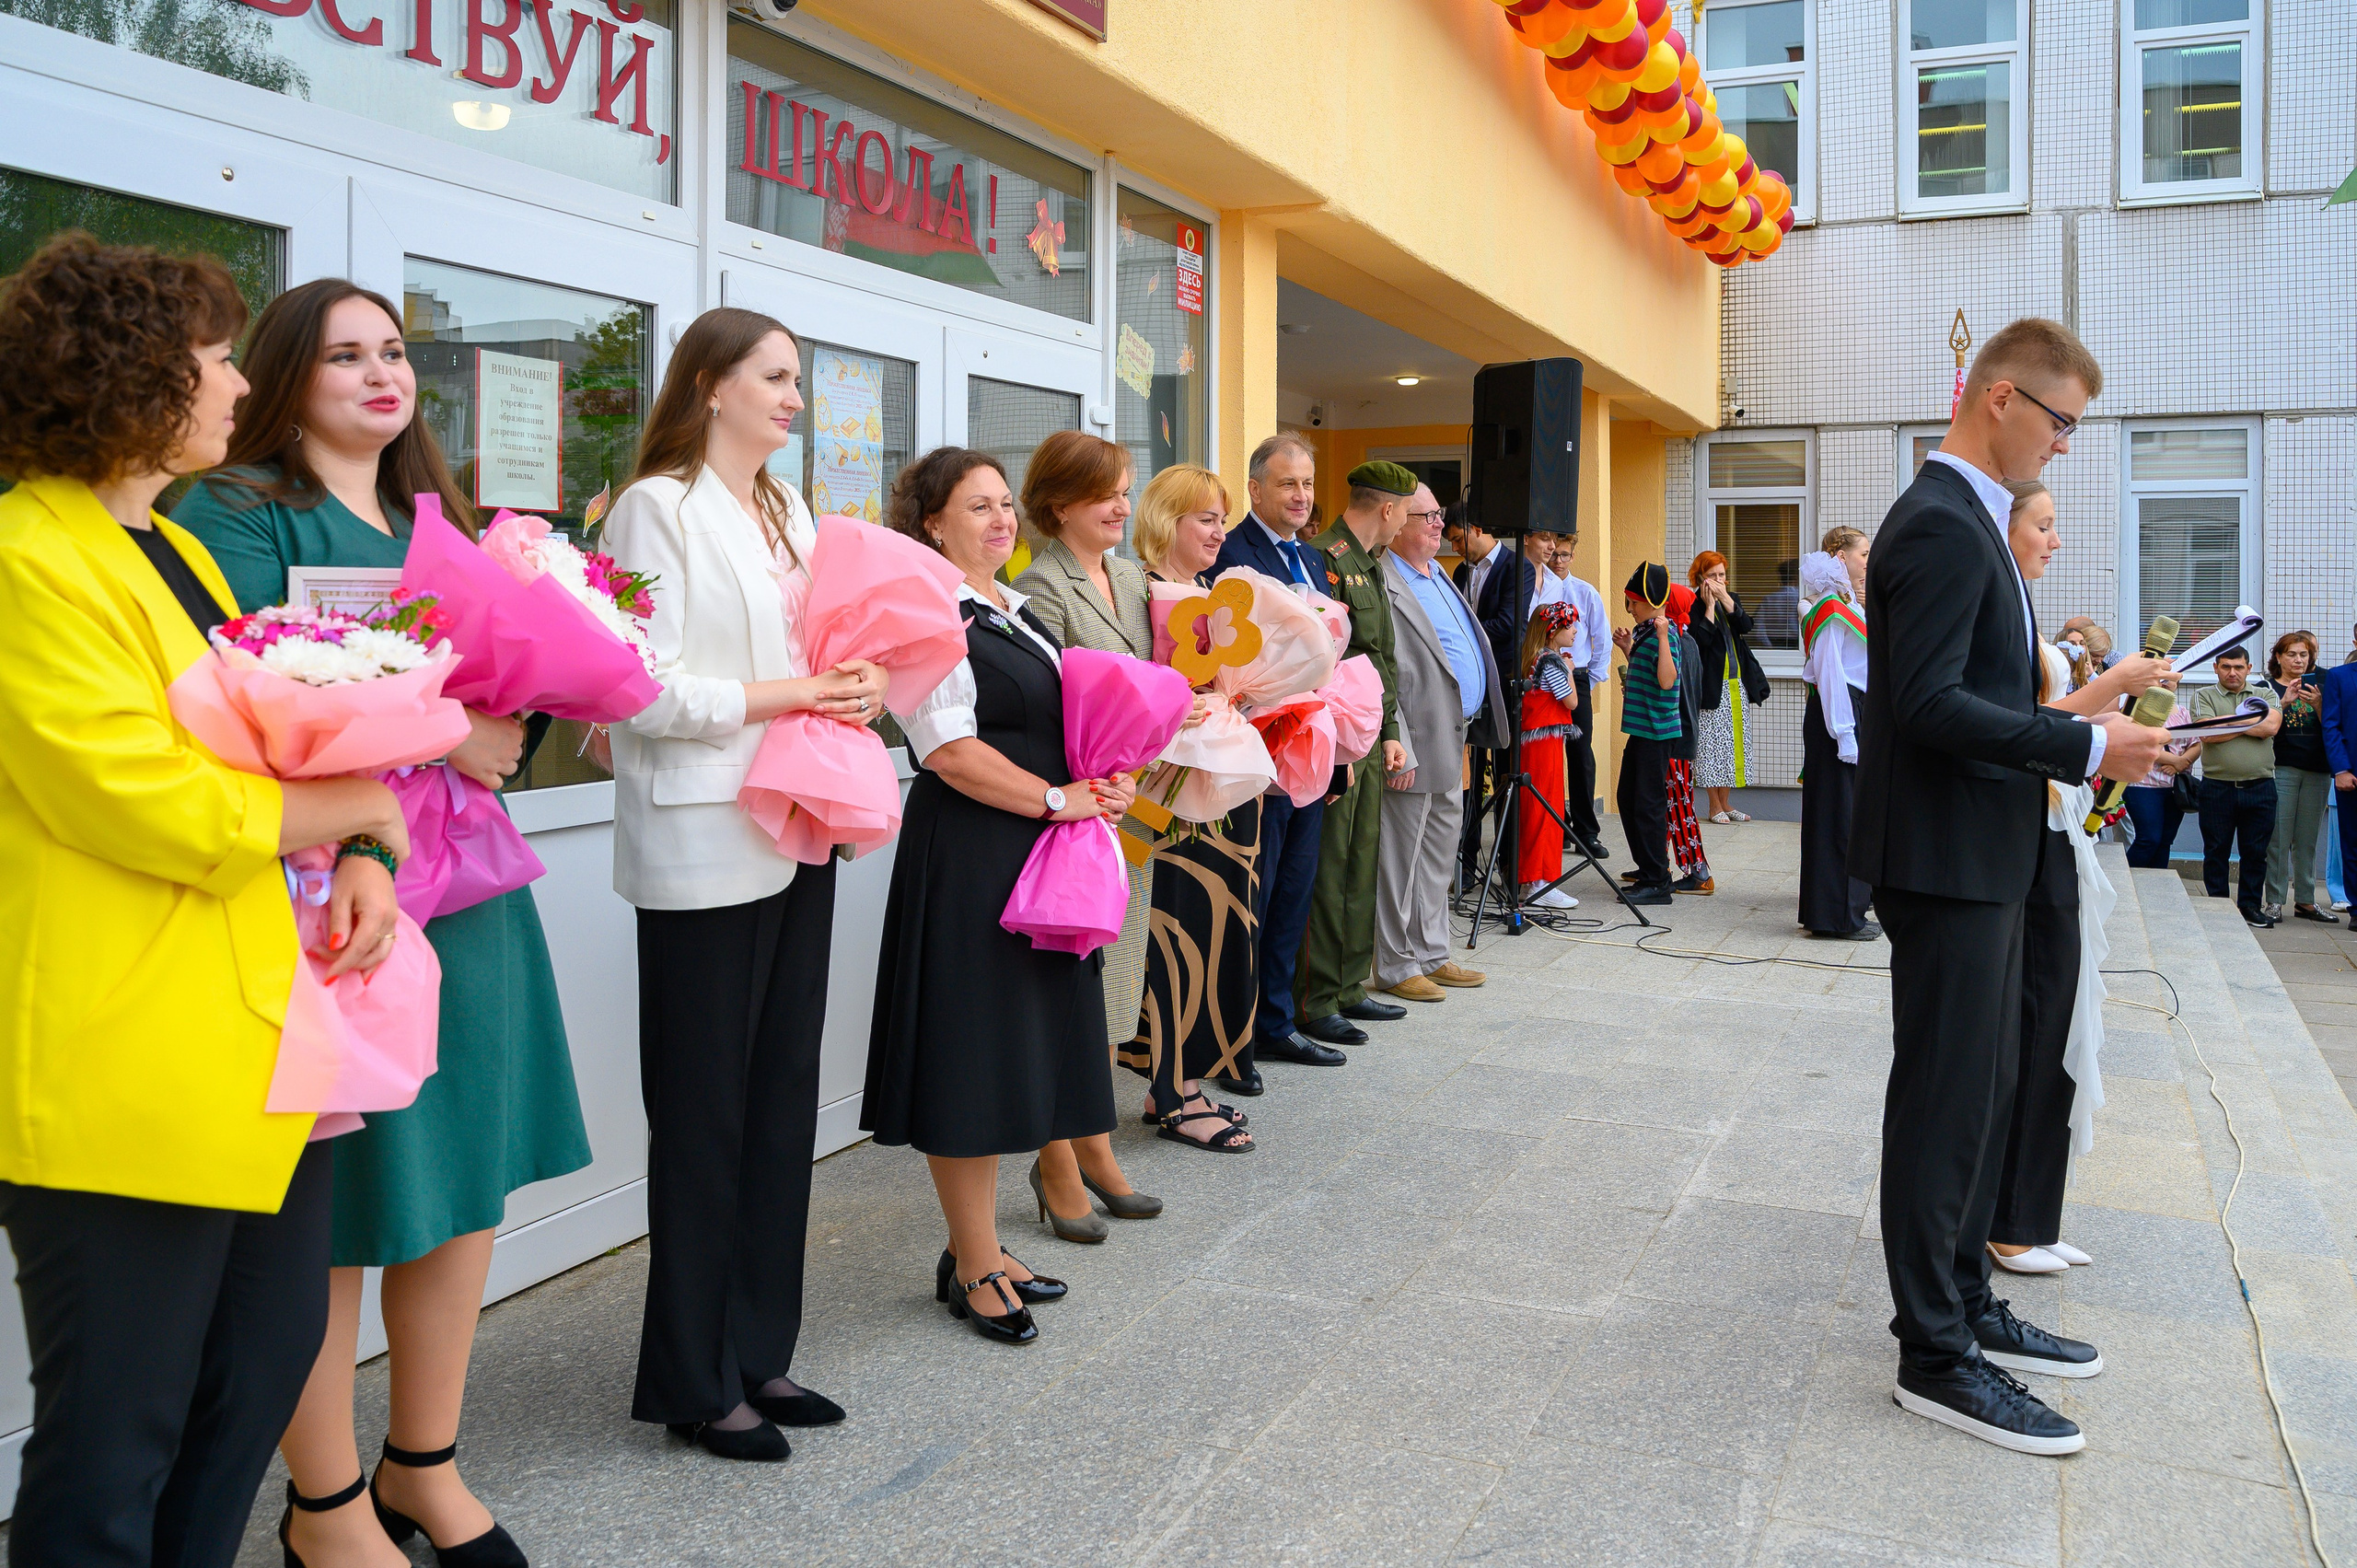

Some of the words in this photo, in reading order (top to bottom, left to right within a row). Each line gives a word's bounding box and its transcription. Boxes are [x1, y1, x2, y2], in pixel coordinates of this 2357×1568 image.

[740, 80, 998, 254] ШКОЛА!
[1178, 268, 1201, 288] ЗДЕСЬ
[1178, 296, 1201, 312] МИЛИЦИЮ
[491, 363, 552, 382] ВНИМАНИЕ!
[510, 383, 527, 394] Вход
[500, 399, 543, 411] учреждение
[498, 412, 544, 425] образования
[491, 427, 525, 438] разрешен
[527, 432, 552, 441] только
[499, 442, 536, 453] учащимся
[497, 457, 545, 468] сотрудникам
[506, 472, 536, 481] школы.
